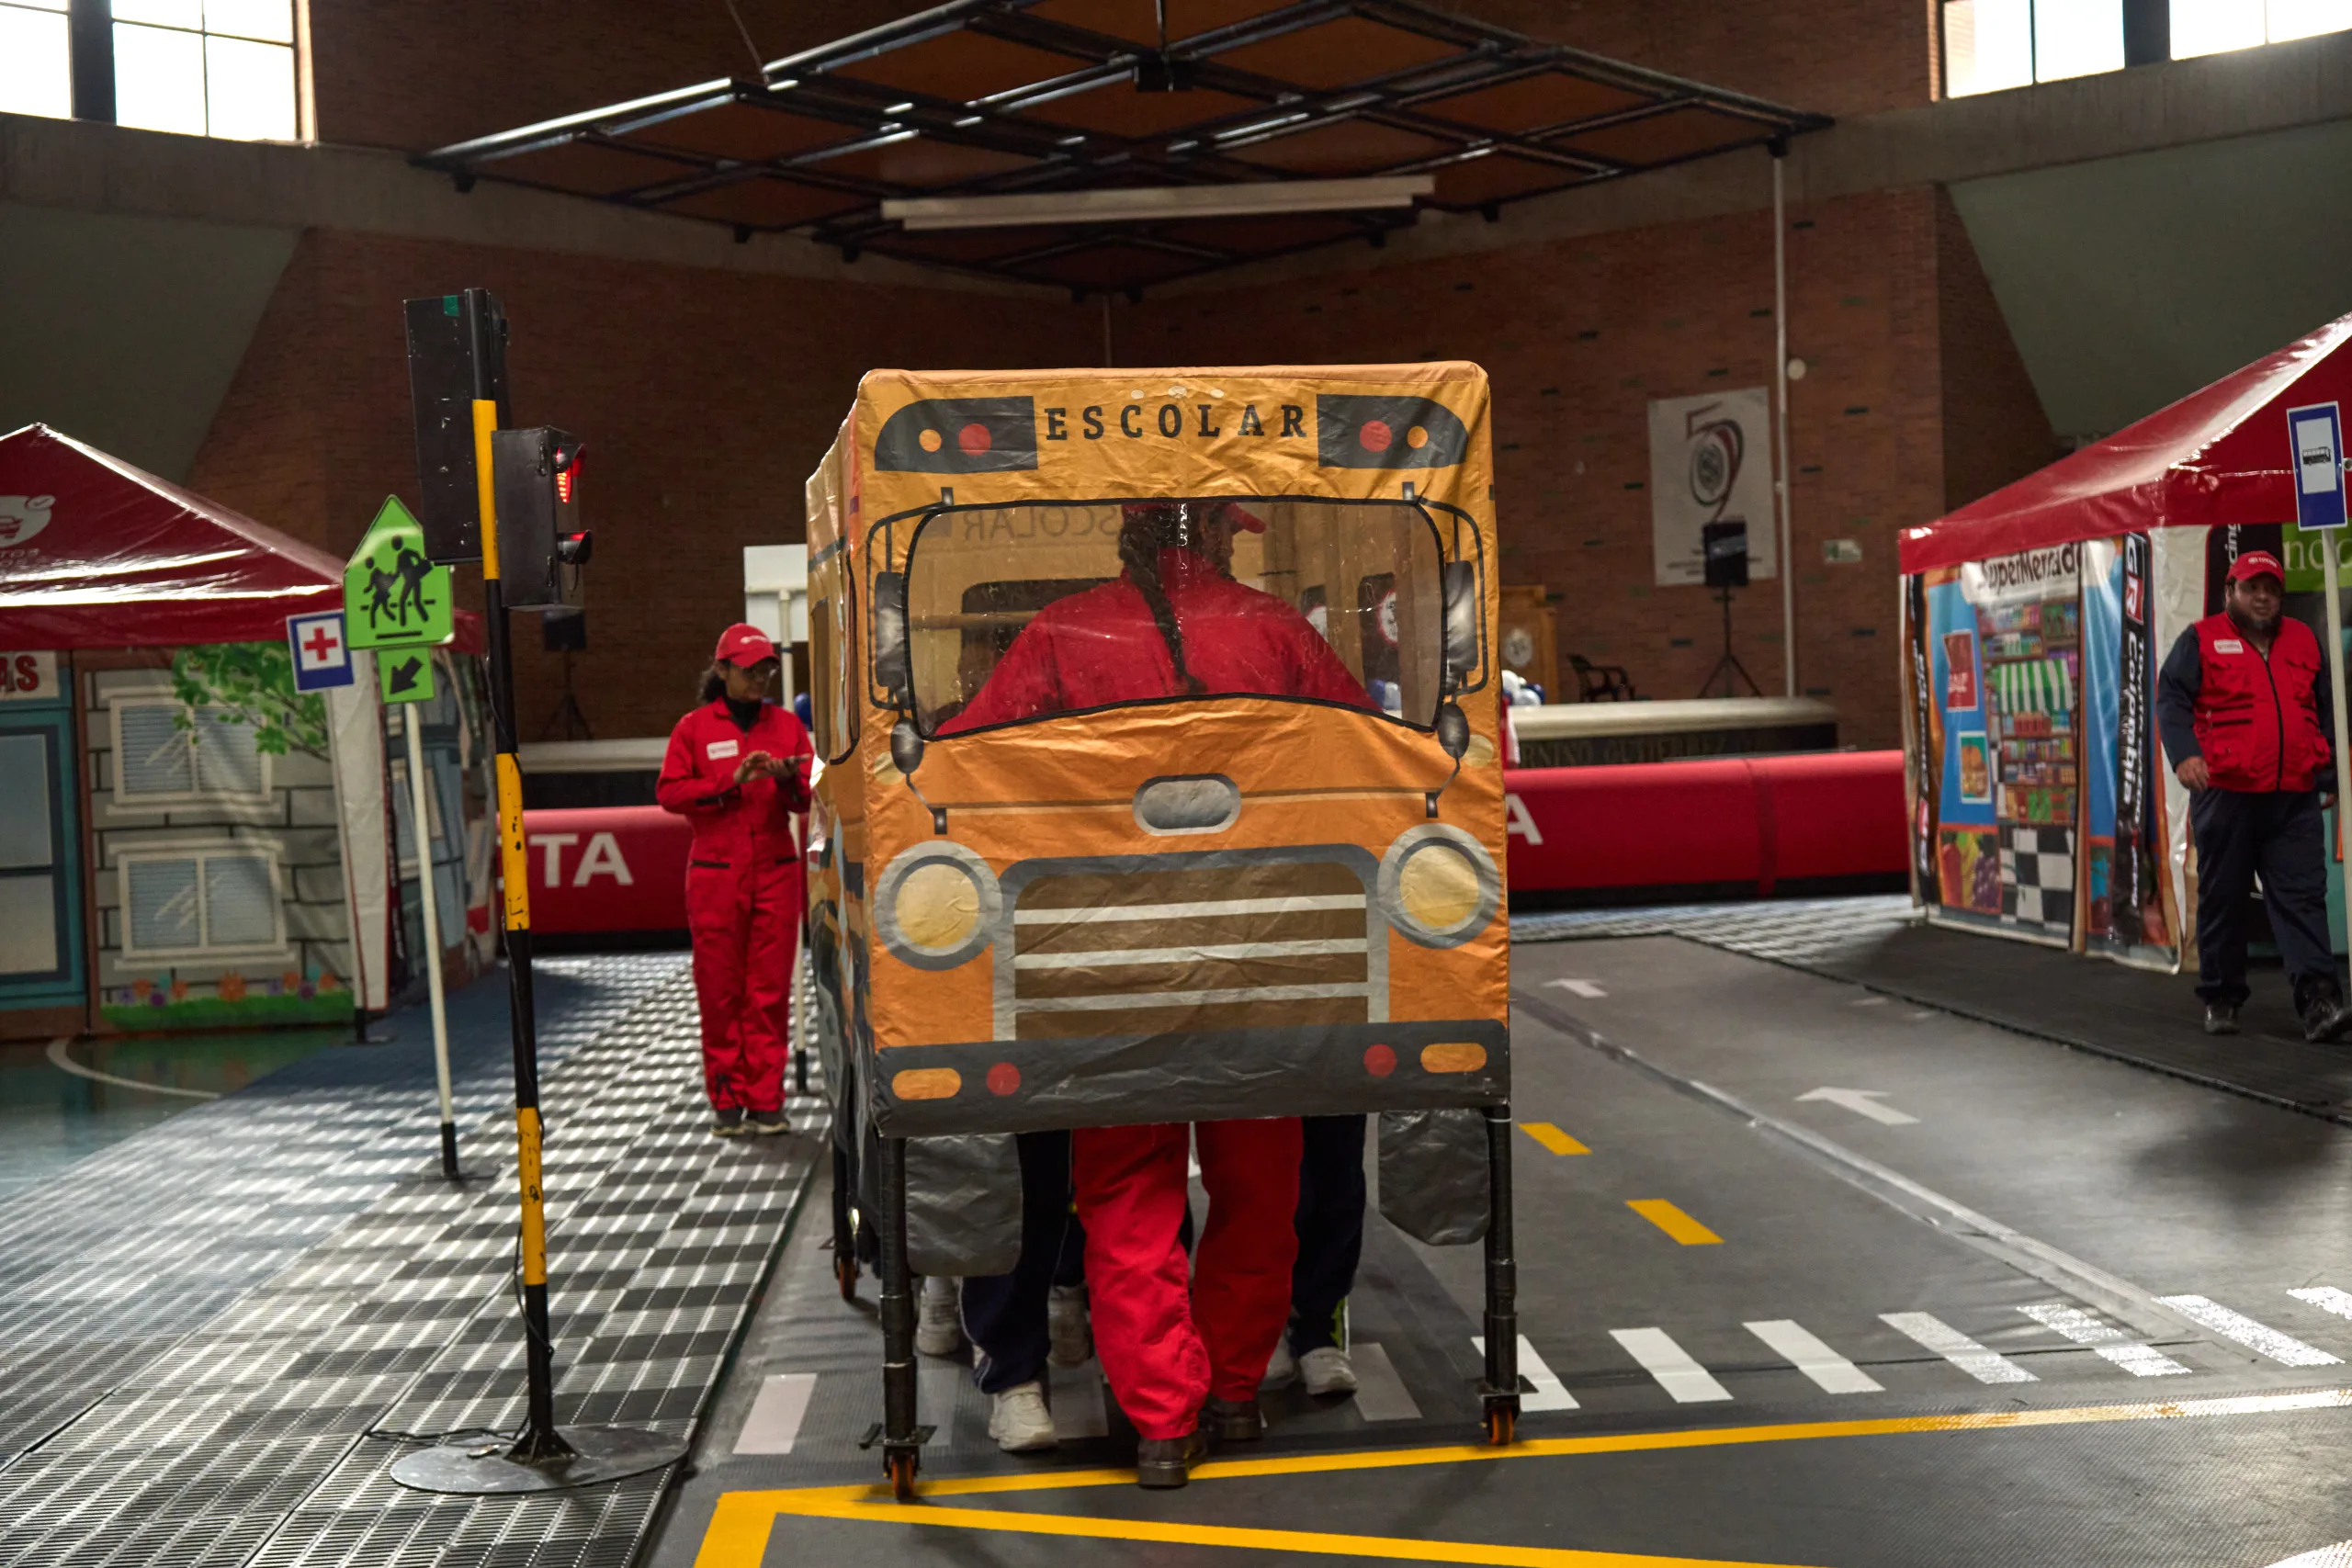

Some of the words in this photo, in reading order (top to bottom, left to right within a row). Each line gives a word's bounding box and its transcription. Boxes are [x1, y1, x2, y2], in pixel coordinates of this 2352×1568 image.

[1044, 404, 1306, 440] ESCOLAR
[2224, 523, 2242, 565] cing
[497, 832, 634, 889] TA
